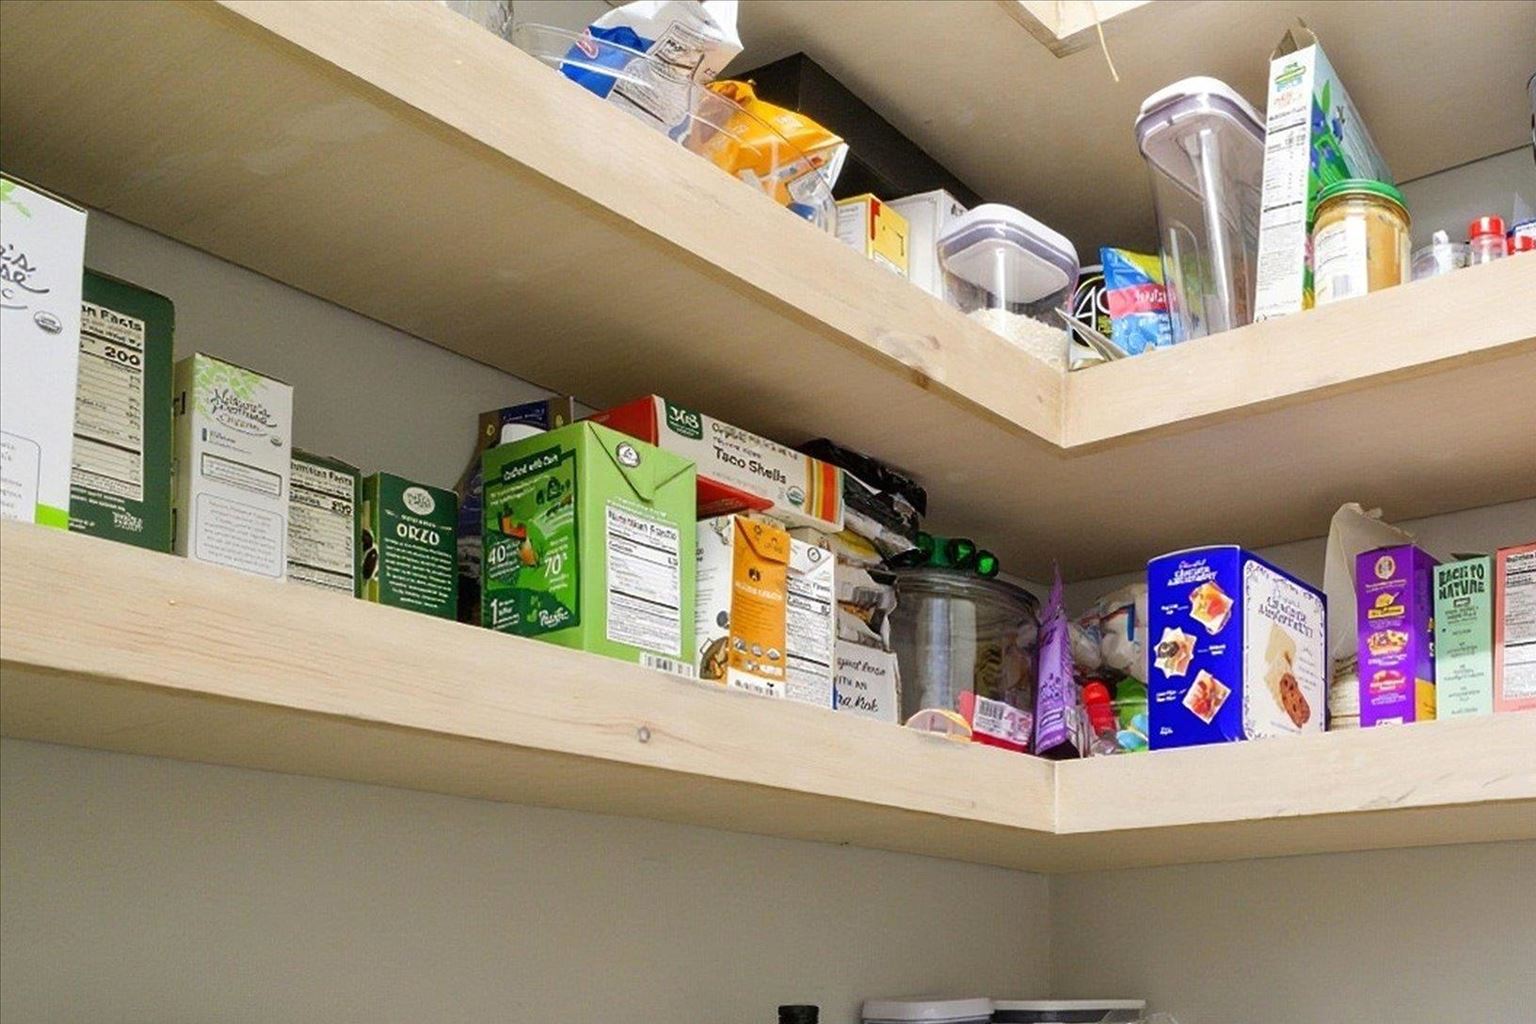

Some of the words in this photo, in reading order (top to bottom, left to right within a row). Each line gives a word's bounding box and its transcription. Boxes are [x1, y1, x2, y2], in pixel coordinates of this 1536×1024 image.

[104, 345, 141, 366] 200
[713, 445, 746, 469] Taco
[749, 460, 787, 485] Shells
[396, 523, 440, 546] ORZO
[1438, 565, 1469, 588] BACK
[1470, 563, 1485, 581] TO
[1438, 579, 1485, 600] NATURE
